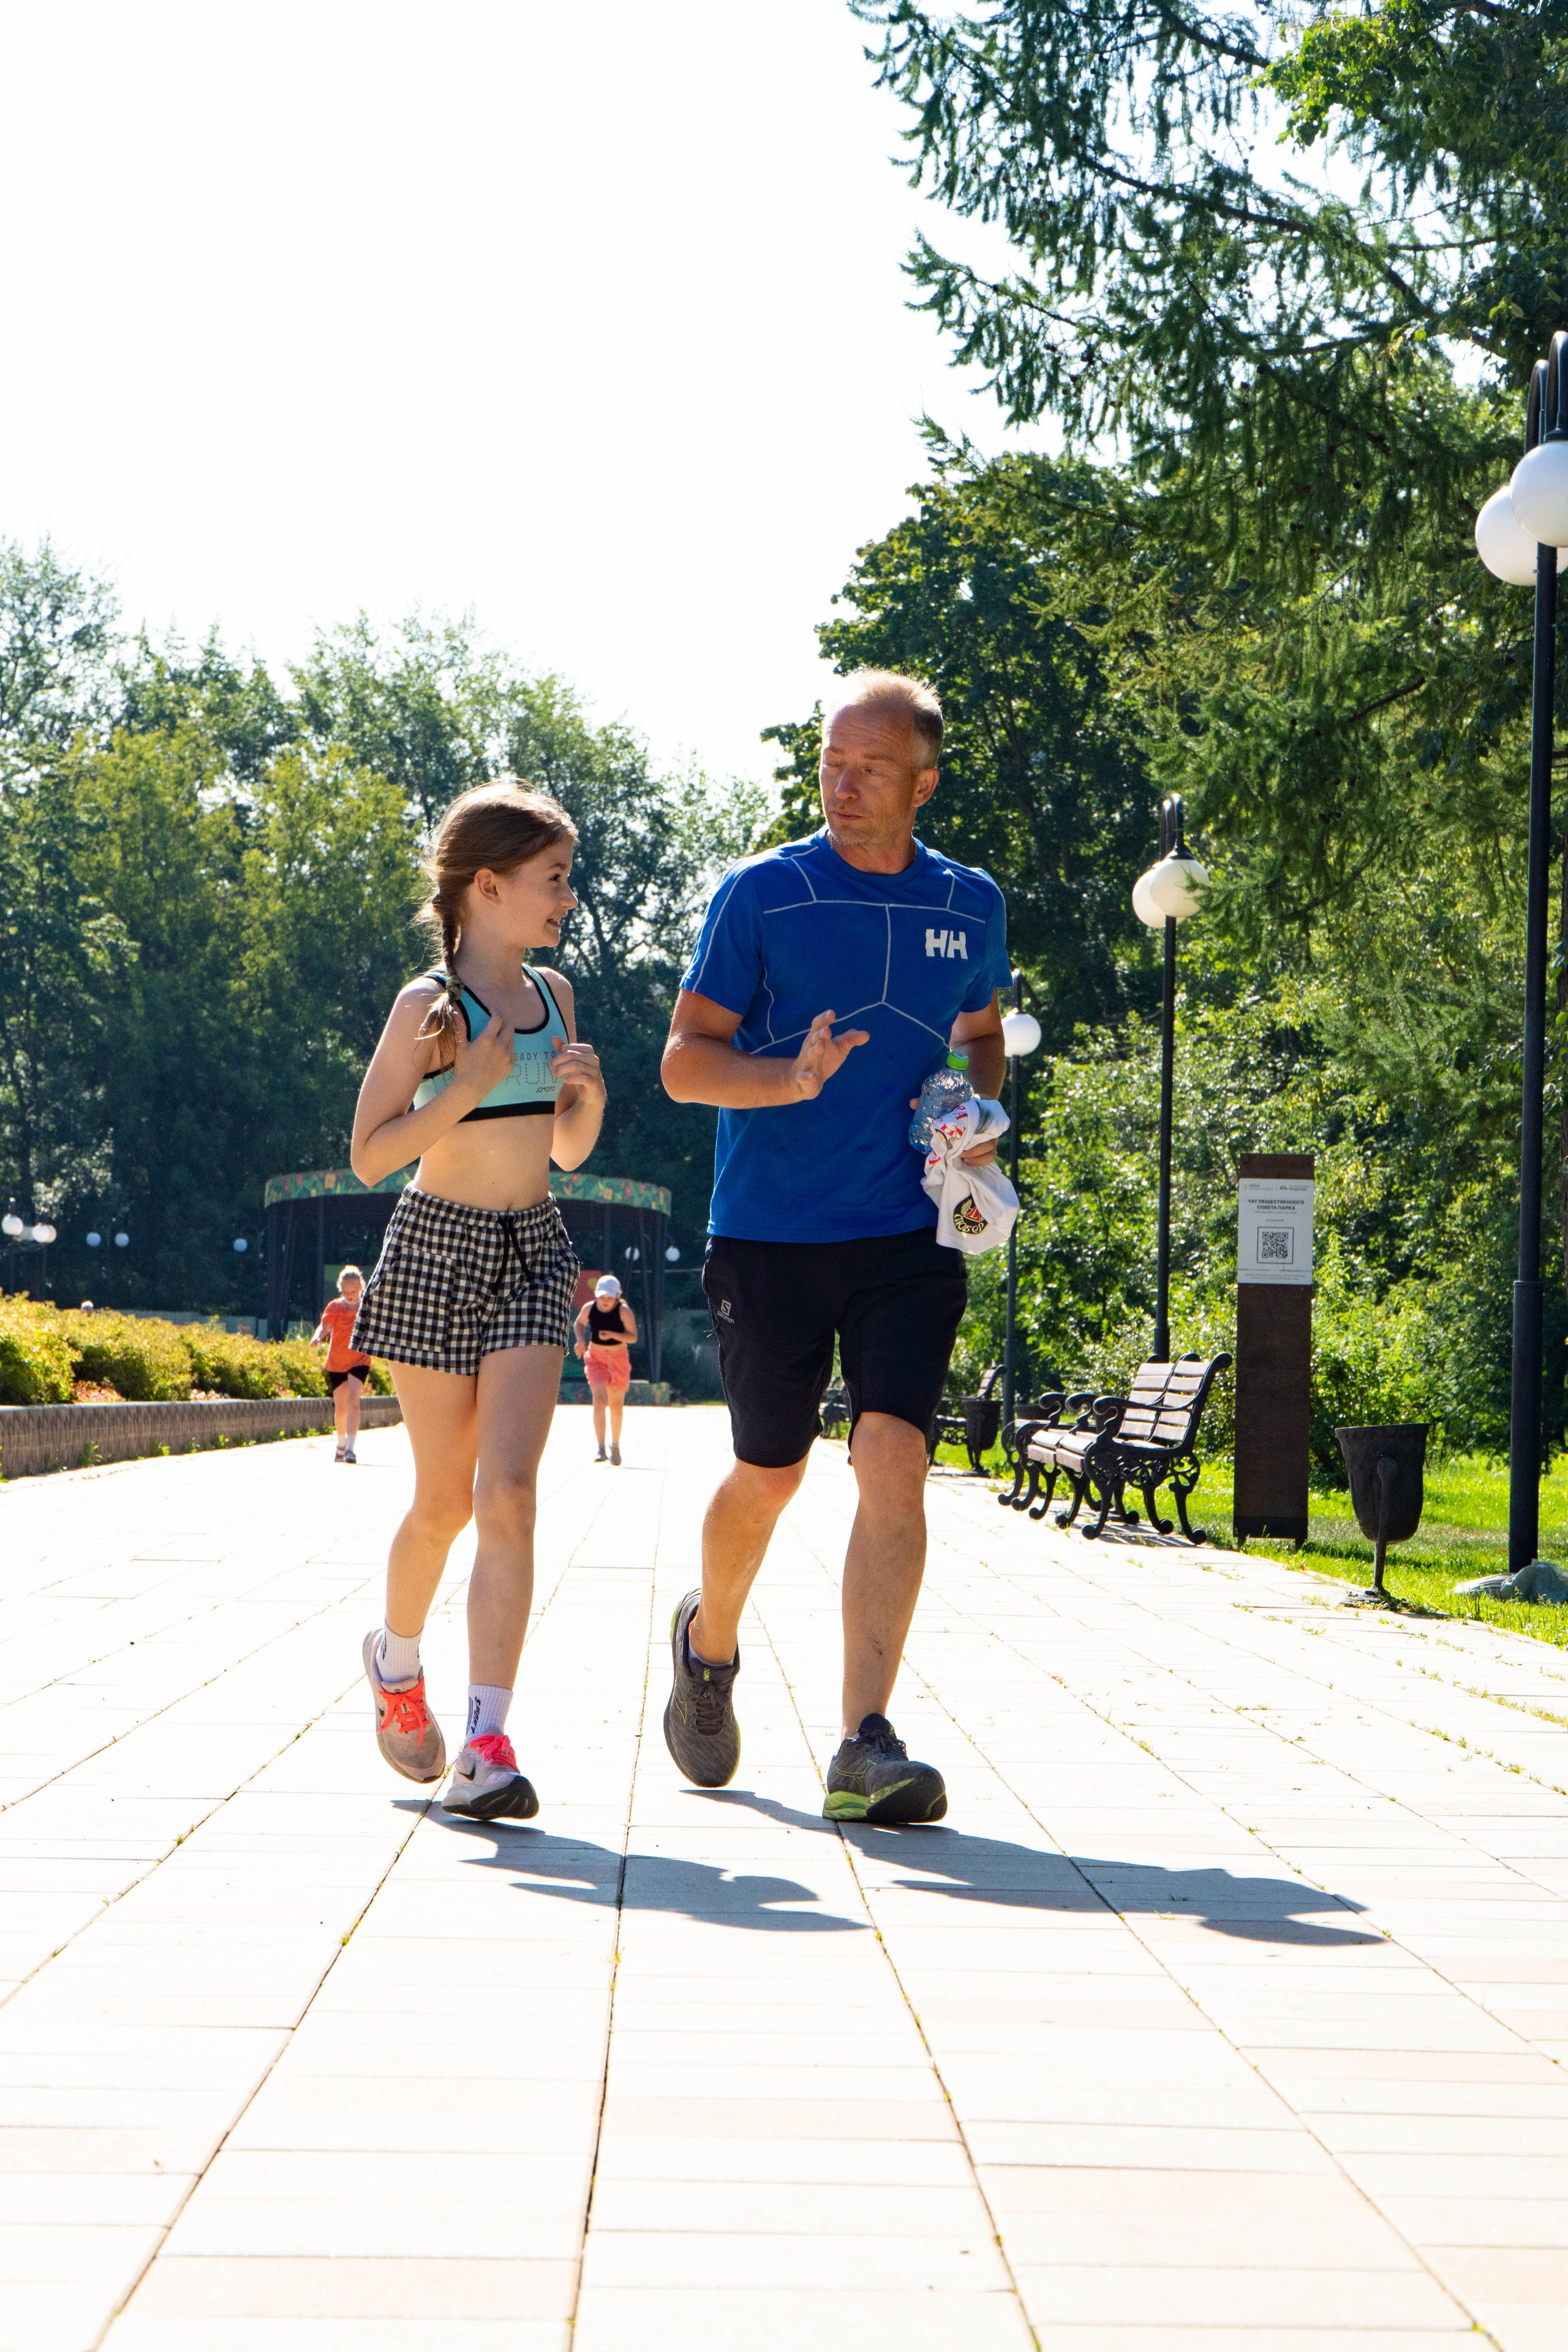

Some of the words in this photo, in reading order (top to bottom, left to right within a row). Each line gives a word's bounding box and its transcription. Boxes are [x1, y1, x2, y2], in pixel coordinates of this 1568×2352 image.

[925, 929, 968, 960] HH
[505, 1062, 558, 1086] RUN
[717, 1310, 734, 1324] salomon
[470, 1696, 481, 1733] SPORT
